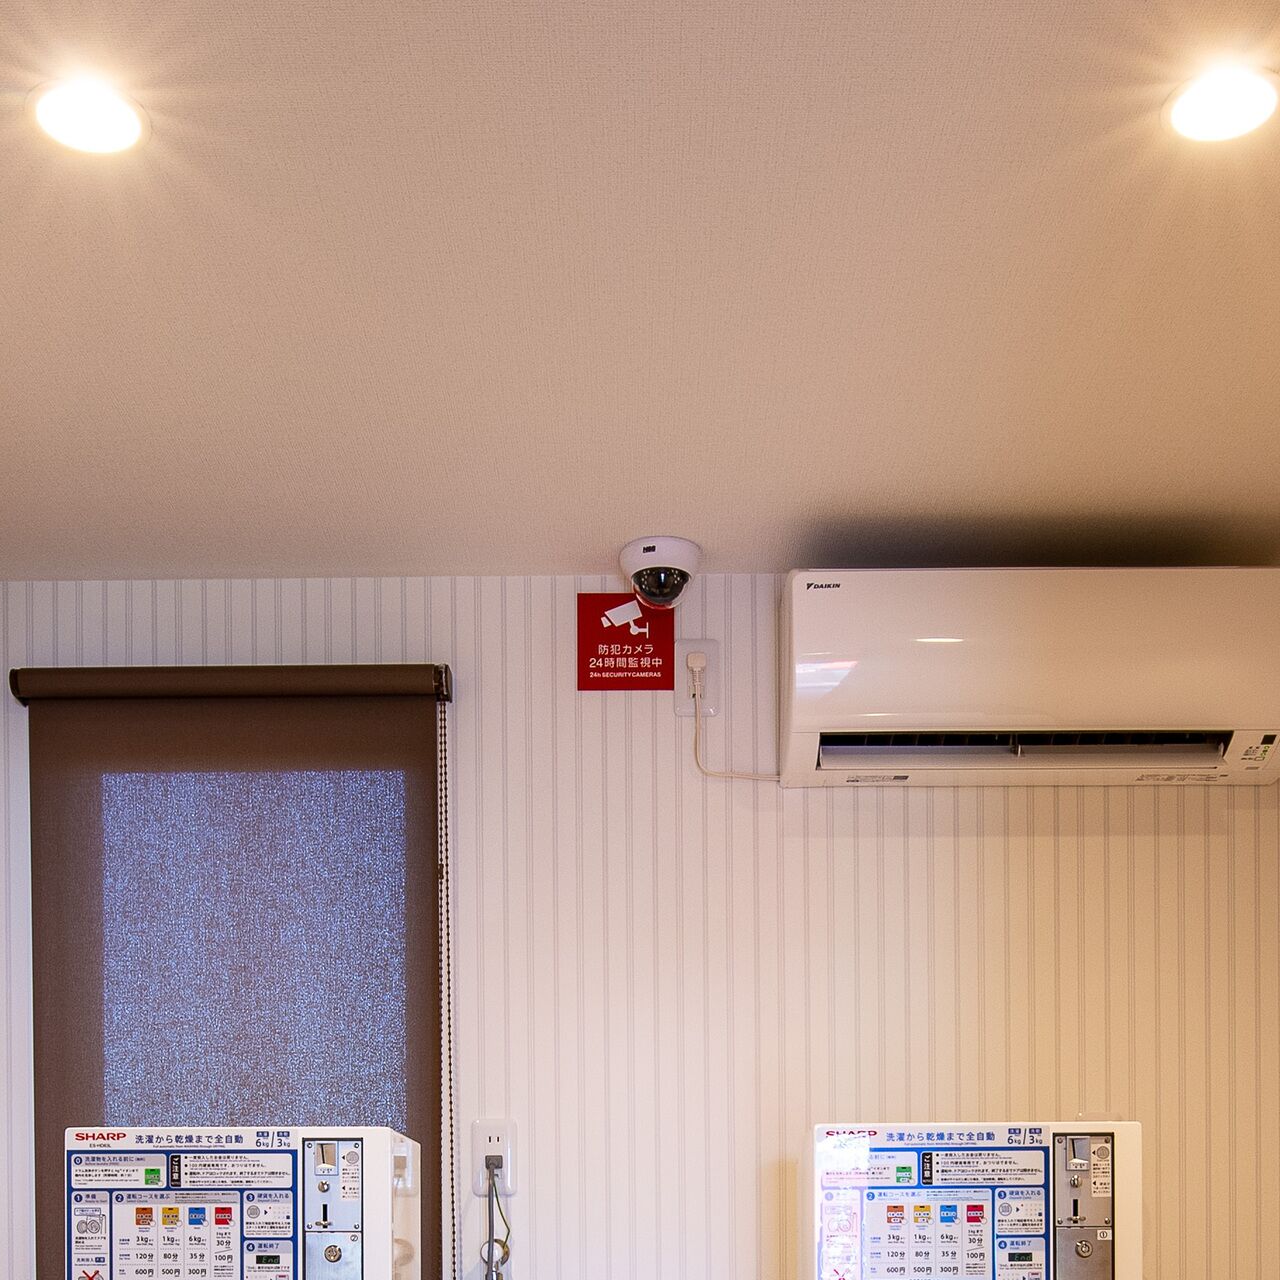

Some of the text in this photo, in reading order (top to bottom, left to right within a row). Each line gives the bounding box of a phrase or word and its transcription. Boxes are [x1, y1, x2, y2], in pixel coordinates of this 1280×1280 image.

[598, 644, 654, 655] 防犯カメラ
[589, 657, 663, 668] 24時間監視中
[75, 1133, 126, 1141] SHARP
[135, 1134, 244, 1144] 洗濯から乾燥まで全自動
[887, 1132, 996, 1141] 洗濯から乾燥まで全自動
[1007, 1135, 1043, 1145] 6kg 3kg
[256, 1139, 290, 1148] 6kg 3kg
[172, 1157, 180, 1180] ご注意
[923, 1154, 932, 1177] ご注意
